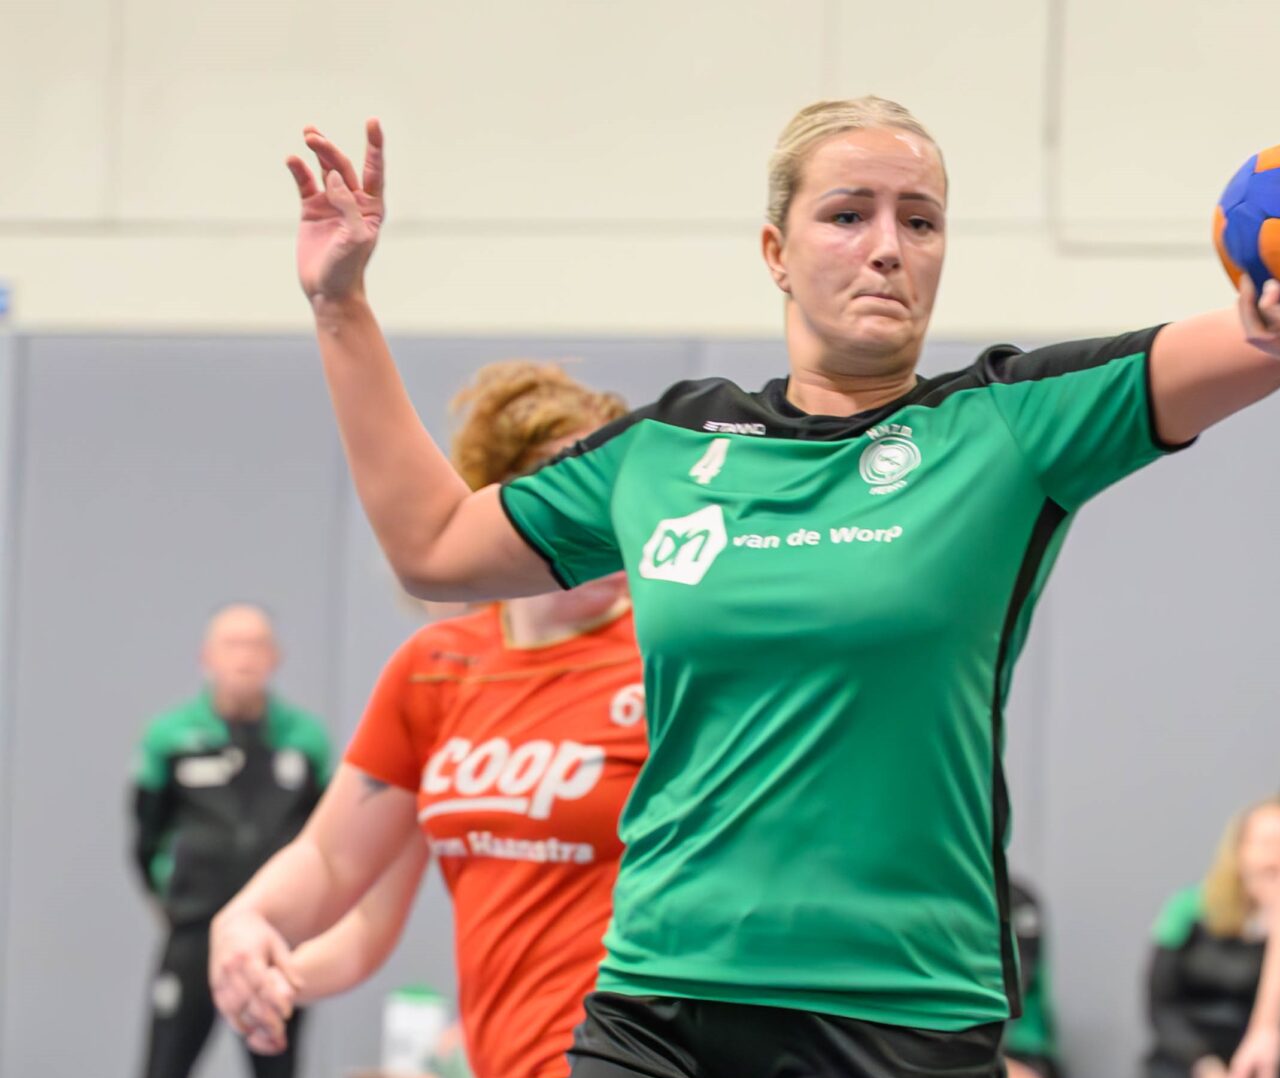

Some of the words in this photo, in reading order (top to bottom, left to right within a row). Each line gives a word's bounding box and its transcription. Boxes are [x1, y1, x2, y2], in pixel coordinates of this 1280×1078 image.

[688, 437, 732, 485] 4
[733, 533, 781, 549] van
[786, 527, 821, 546] de
[609, 683, 645, 727] 6
